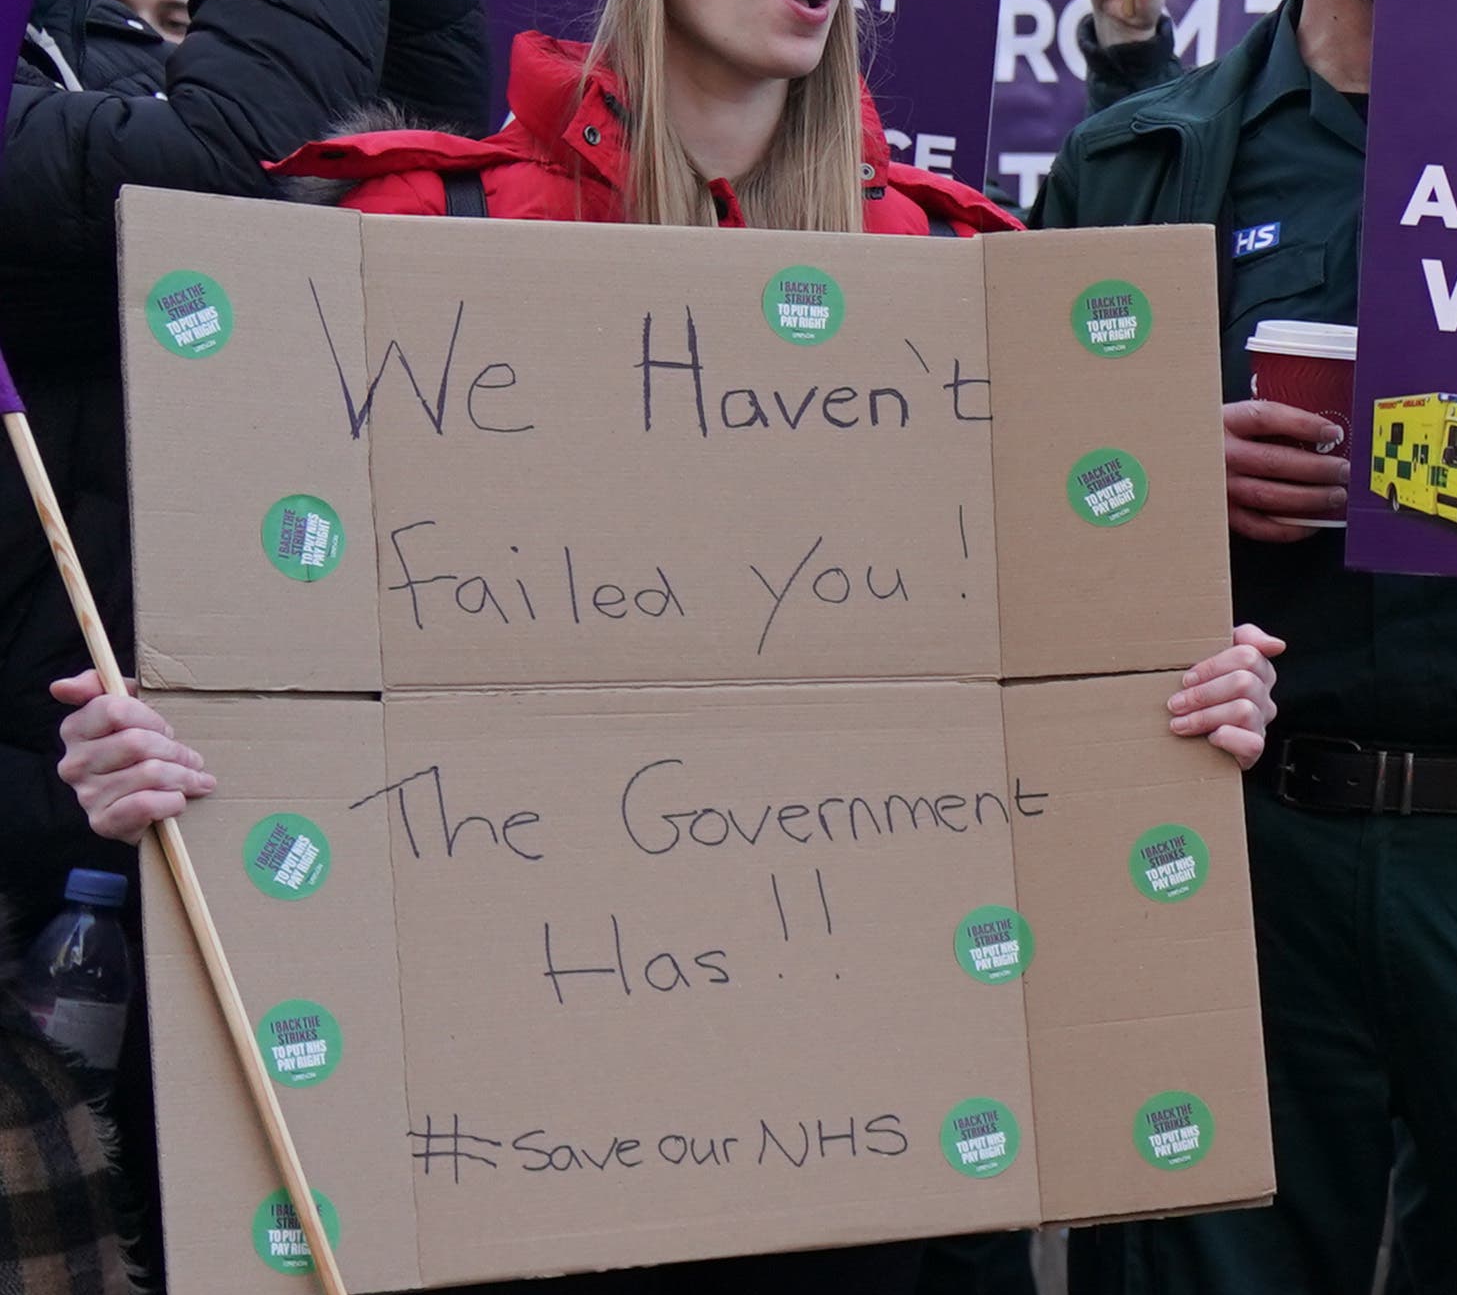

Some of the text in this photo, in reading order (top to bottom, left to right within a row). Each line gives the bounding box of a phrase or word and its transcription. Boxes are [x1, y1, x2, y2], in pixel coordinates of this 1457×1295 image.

[785, 281, 809, 293] BACK
[810, 283, 827, 295] THE
[785, 293, 822, 305] STRIKES
[1091, 296, 1115, 309] BACK
[1116, 294, 1133, 306] THE
[777, 303, 829, 318] TO PUT NHS
[1093, 307, 1129, 320] STRIKES
[781, 316, 826, 329] PAY RIGHT
[1086, 316, 1137, 332] TO PUT NHS
[1091, 328, 1135, 343] PAY RIGHT
[309, 277, 995, 440] We Haven't
[348, 759, 1049, 860] The Government
[275, 1018, 302, 1033] BACK
[302, 1015, 320, 1028] THE
[278, 1029, 317, 1045] STRIKES
[271, 1039, 327, 1059] TO PUT NHS
[277, 1054, 325, 1072] PAY RIGHT
[958, 1114, 982, 1128] BACK
[982, 1110, 999, 1123] THE
[961, 1123, 997, 1140] STRIKES
[956, 1132, 1006, 1154] TO PUT NHS
[961, 1145, 1006, 1164] PAY RIGHT
